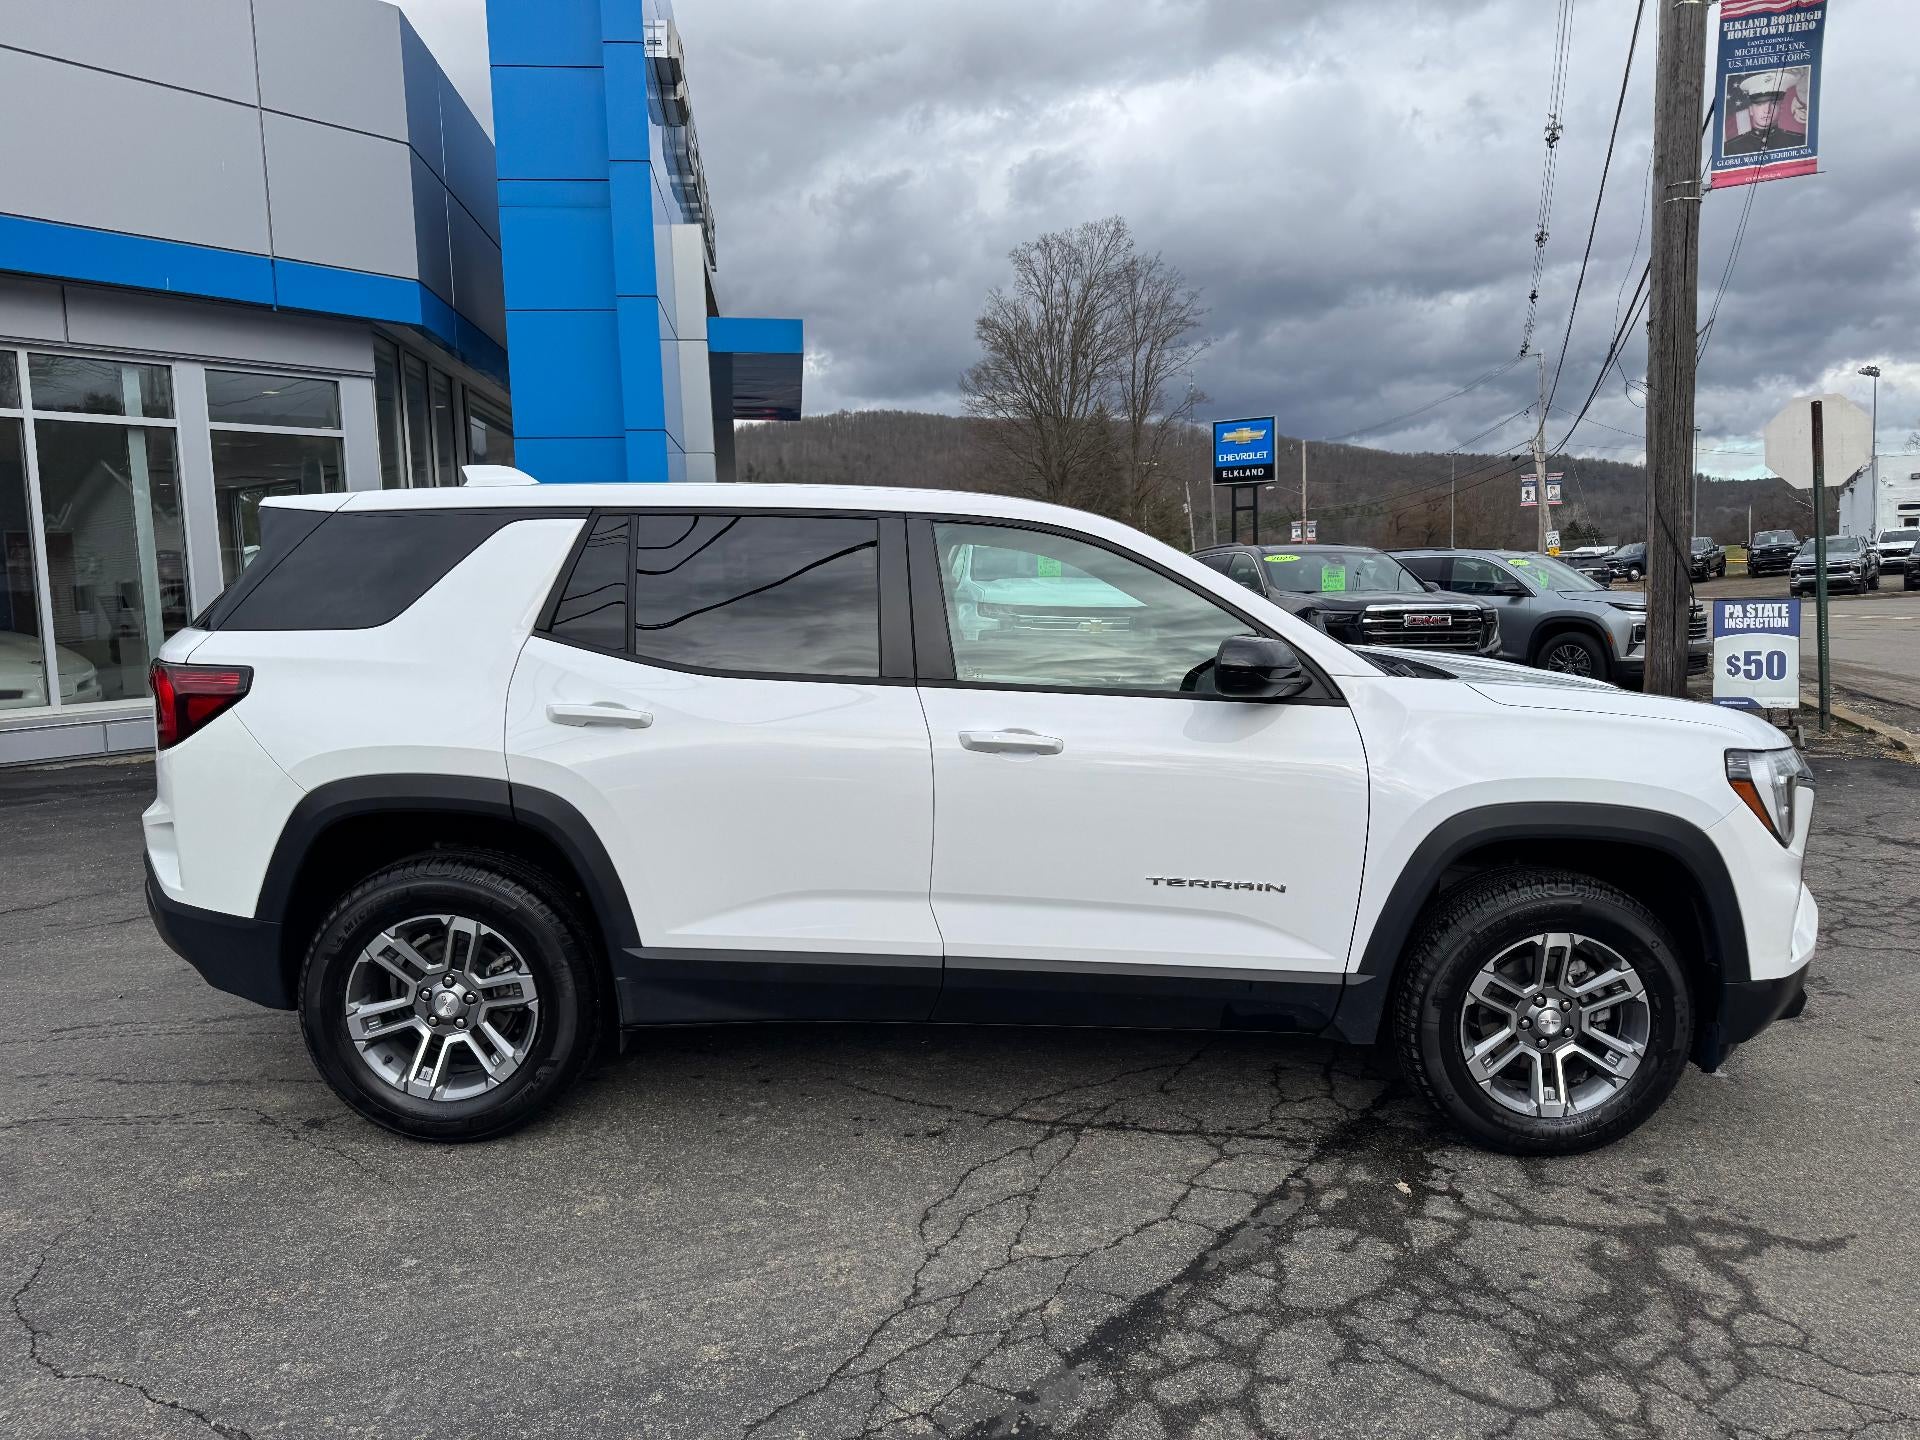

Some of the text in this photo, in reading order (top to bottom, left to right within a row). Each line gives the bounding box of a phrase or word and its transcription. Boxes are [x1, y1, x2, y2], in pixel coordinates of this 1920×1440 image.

[1723, 10, 1822, 31] ELKLAND BOROUGH
[1727, 21, 1816, 40] HOMETOWN HERO
[1734, 42, 1806, 56] MICHAEL PLANK
[1728, 52, 1811, 68] U.S. MARINE CORPS
[1744, 155, 1758, 163] WAR
[1218, 450, 1269, 462] CHEVROLET
[1222, 468, 1265, 478] ELKLAND
[1724, 603, 1790, 618] PA STATE
[1409, 615, 1450, 625] GMC
[1724, 617, 1789, 629] INSPECTION
[1726, 650, 1787, 681] $50
[1145, 876, 1287, 893] TERRAIN
